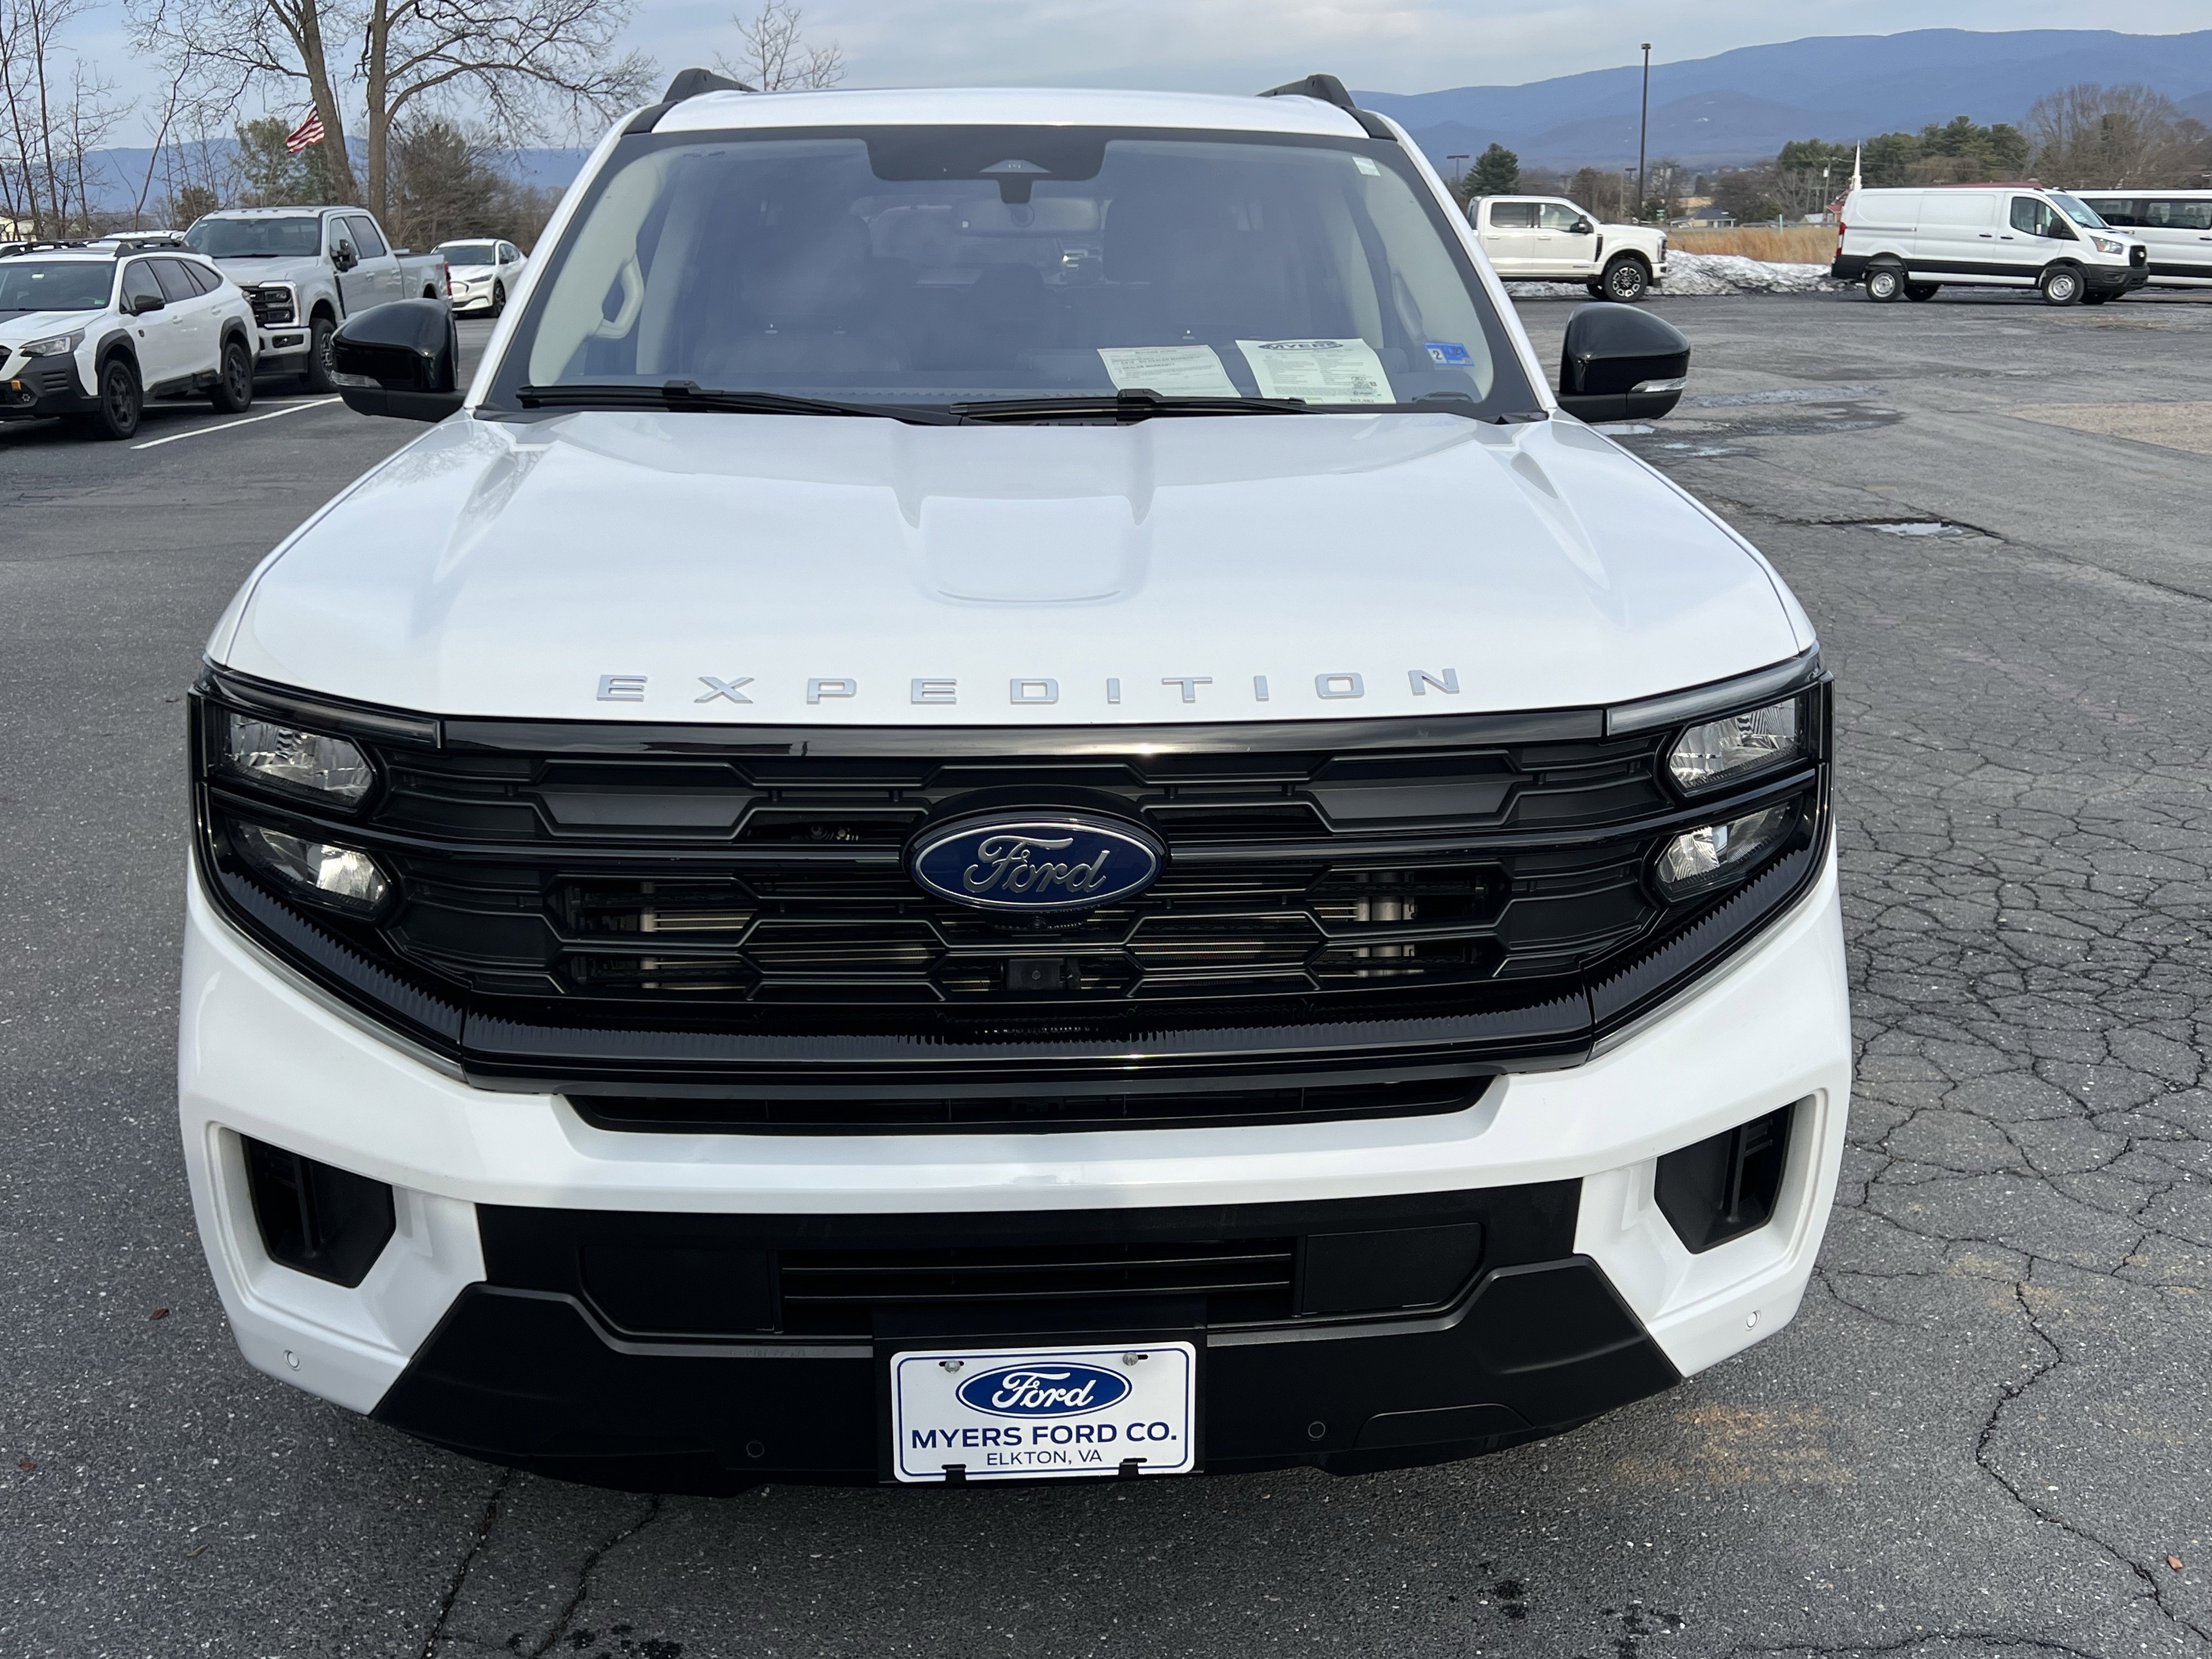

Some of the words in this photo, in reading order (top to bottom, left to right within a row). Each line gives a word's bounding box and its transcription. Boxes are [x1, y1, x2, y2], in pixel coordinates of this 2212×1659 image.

[1432, 350, 1442, 360] 2
[597, 668, 1460, 704] EXPEDITION
[963, 835, 1110, 893] Ford
[992, 1372, 1096, 1408] Ford
[912, 1426, 1023, 1448] MYERS
[1032, 1424, 1116, 1445] FORD
[1126, 1421, 1177, 1442] CO.
[987, 1450, 1073, 1465] ELKTON,
[1079, 1449, 1102, 1462] VA
